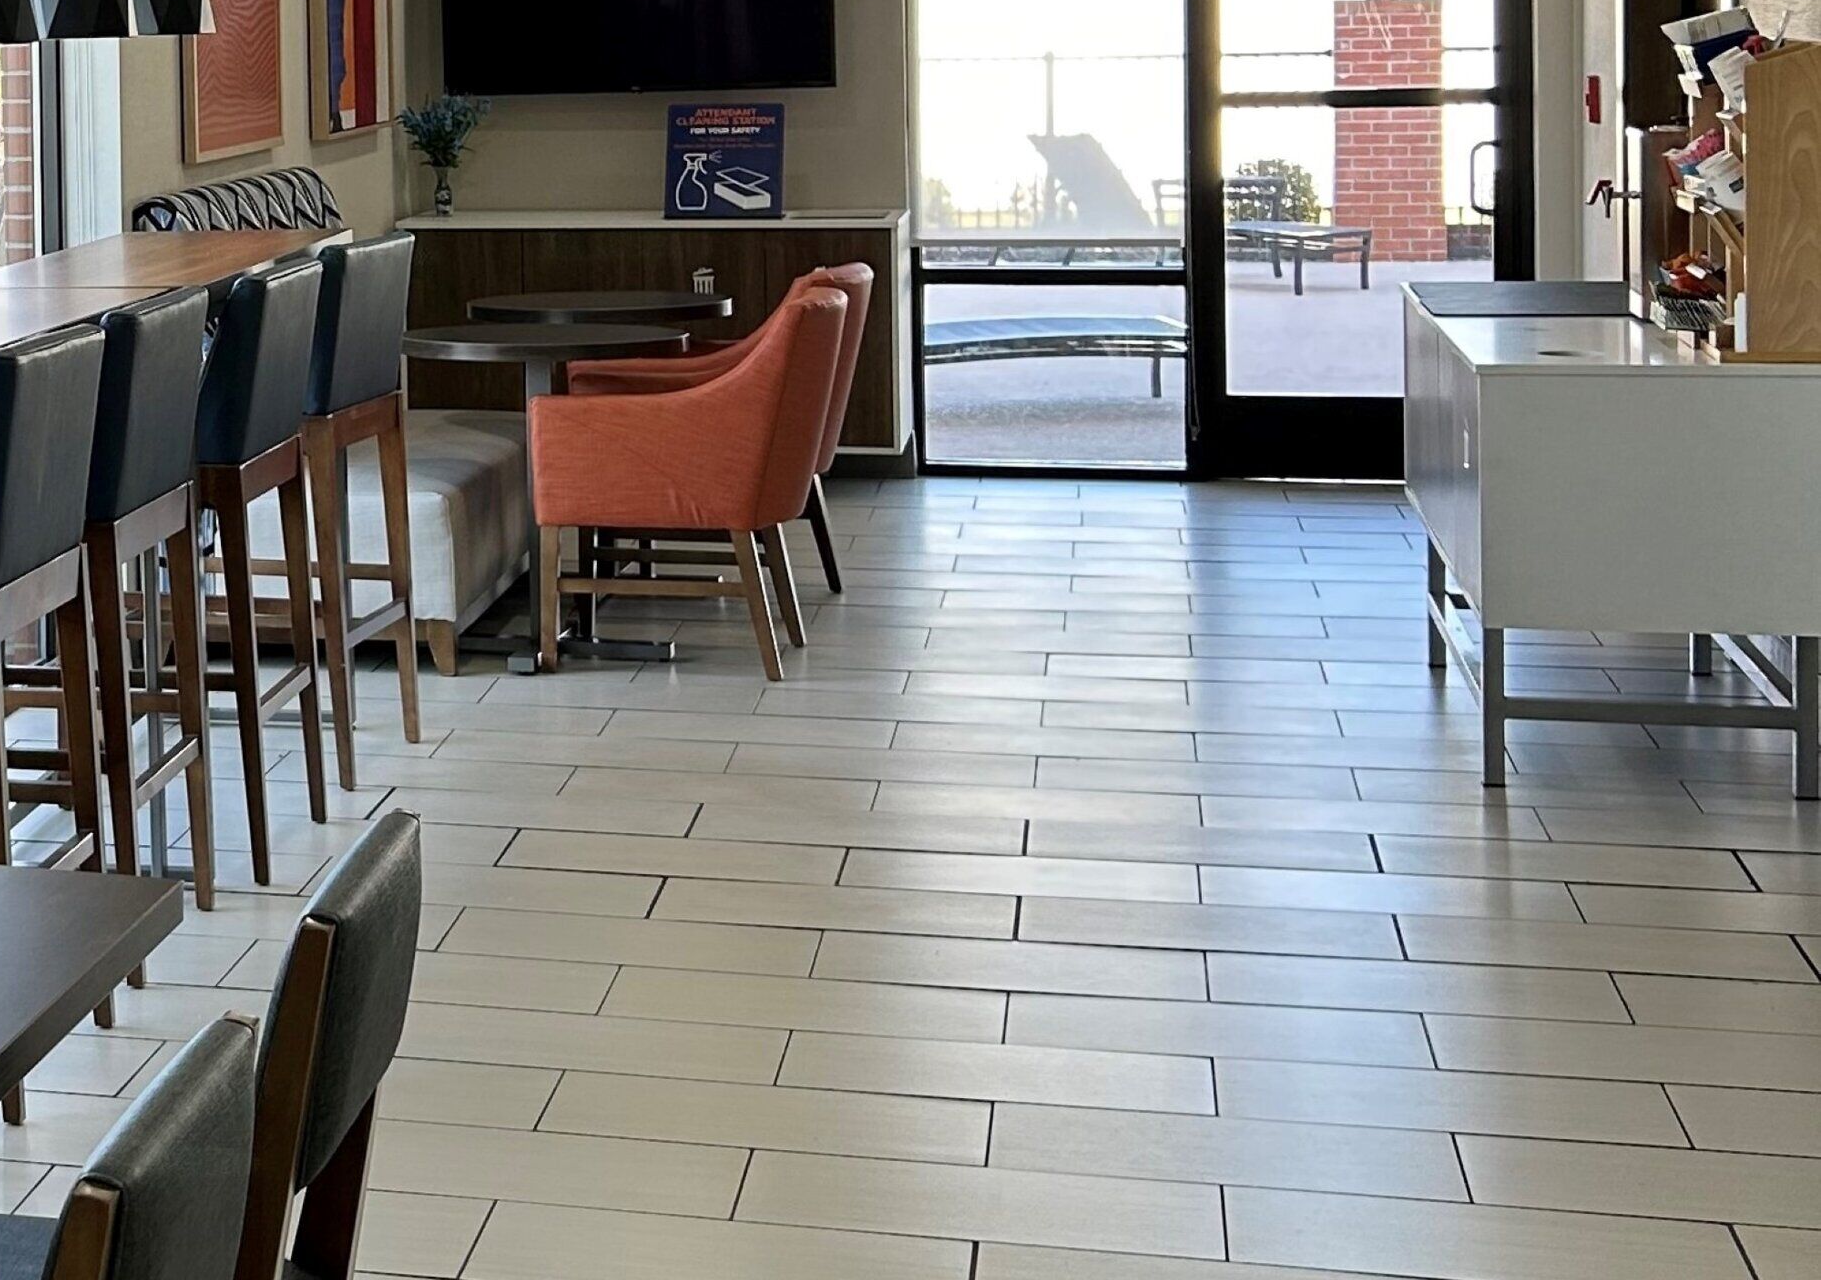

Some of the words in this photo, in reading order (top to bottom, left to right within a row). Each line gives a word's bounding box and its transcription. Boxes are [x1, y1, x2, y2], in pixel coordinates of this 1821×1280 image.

[695, 108, 757, 117] ATTENDANT
[676, 117, 729, 126] CLEANING
[732, 116, 775, 125] STATION
[731, 126, 761, 134] SAFETY
